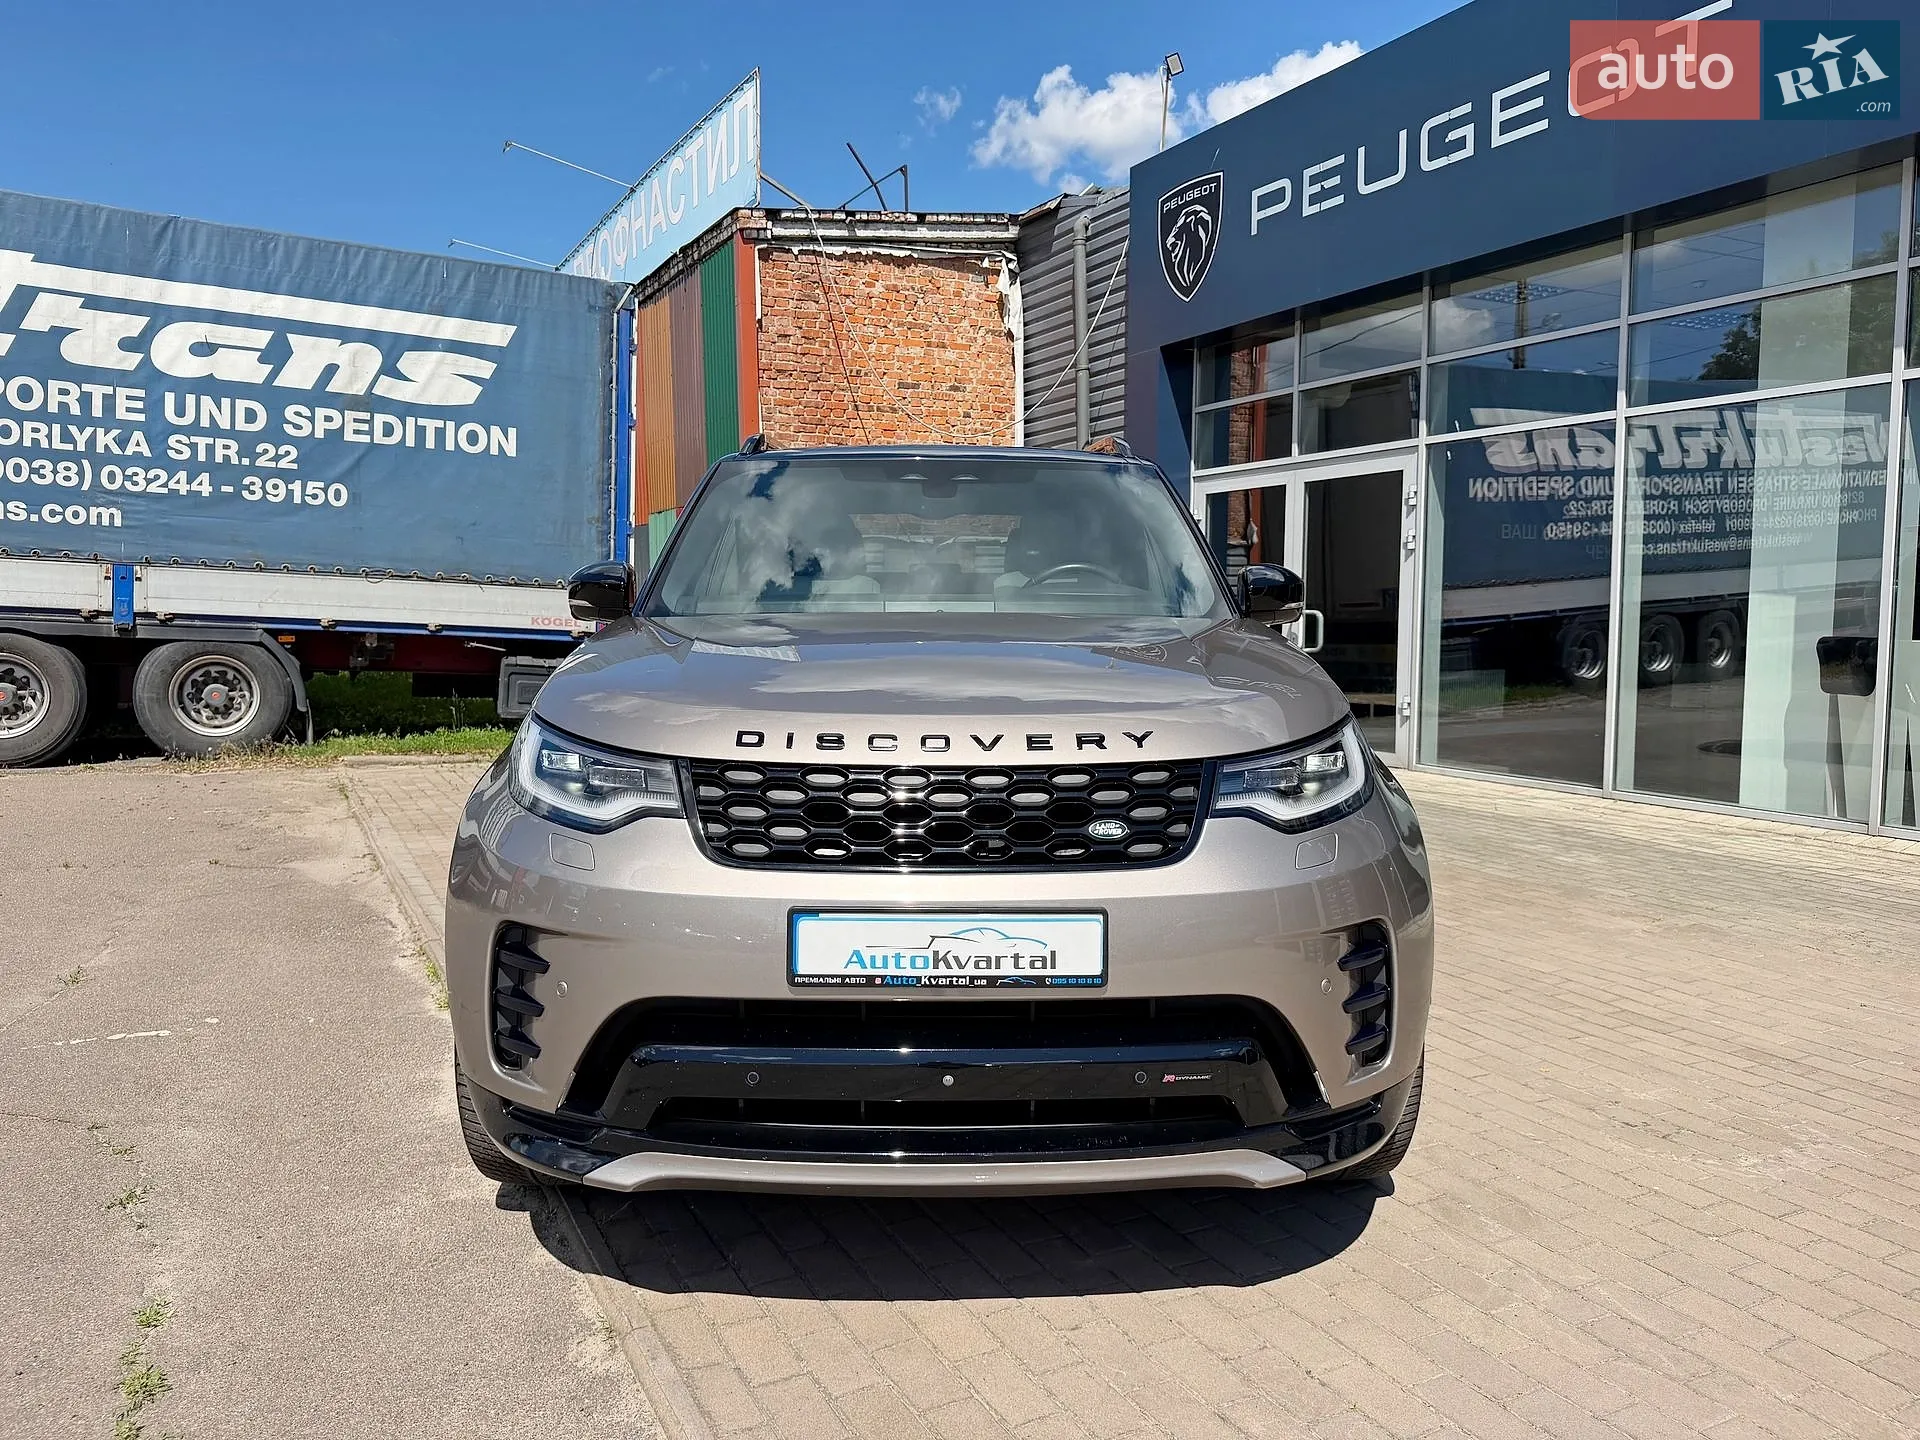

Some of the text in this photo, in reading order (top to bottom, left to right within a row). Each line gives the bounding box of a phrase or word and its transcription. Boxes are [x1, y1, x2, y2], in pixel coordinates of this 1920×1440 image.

[1163, 182, 1218, 214] PEUGEOT
[0, 375, 518, 457] ORTE UND SPEDITION
[0, 456, 93, 491] 038)
[100, 464, 213, 497] 03244
[241, 476, 349, 508] 39150
[0, 500, 122, 528] s.com
[735, 729, 1155, 752] DISCOVERY
[843, 949, 1058, 971] AutoKvartal
[844, 976, 866, 984] АВТО
